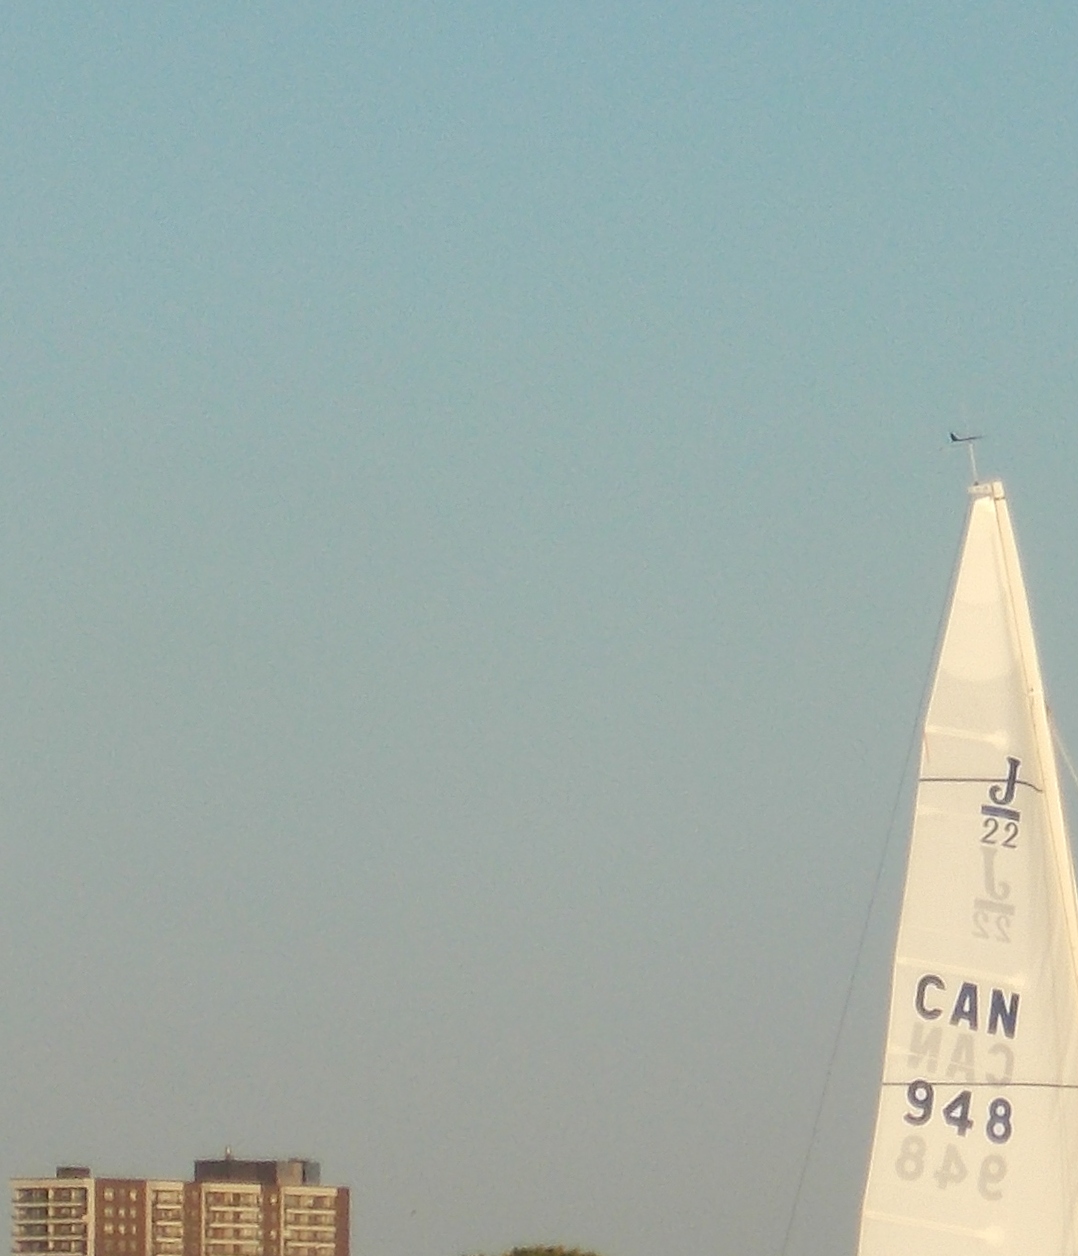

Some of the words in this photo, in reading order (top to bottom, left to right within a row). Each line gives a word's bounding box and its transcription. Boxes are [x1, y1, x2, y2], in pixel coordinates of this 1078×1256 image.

[989, 757, 1021, 806] J
[981, 817, 1020, 849] 22
[915, 974, 1020, 1040] CAN
[903, 1080, 1012, 1144] 948
